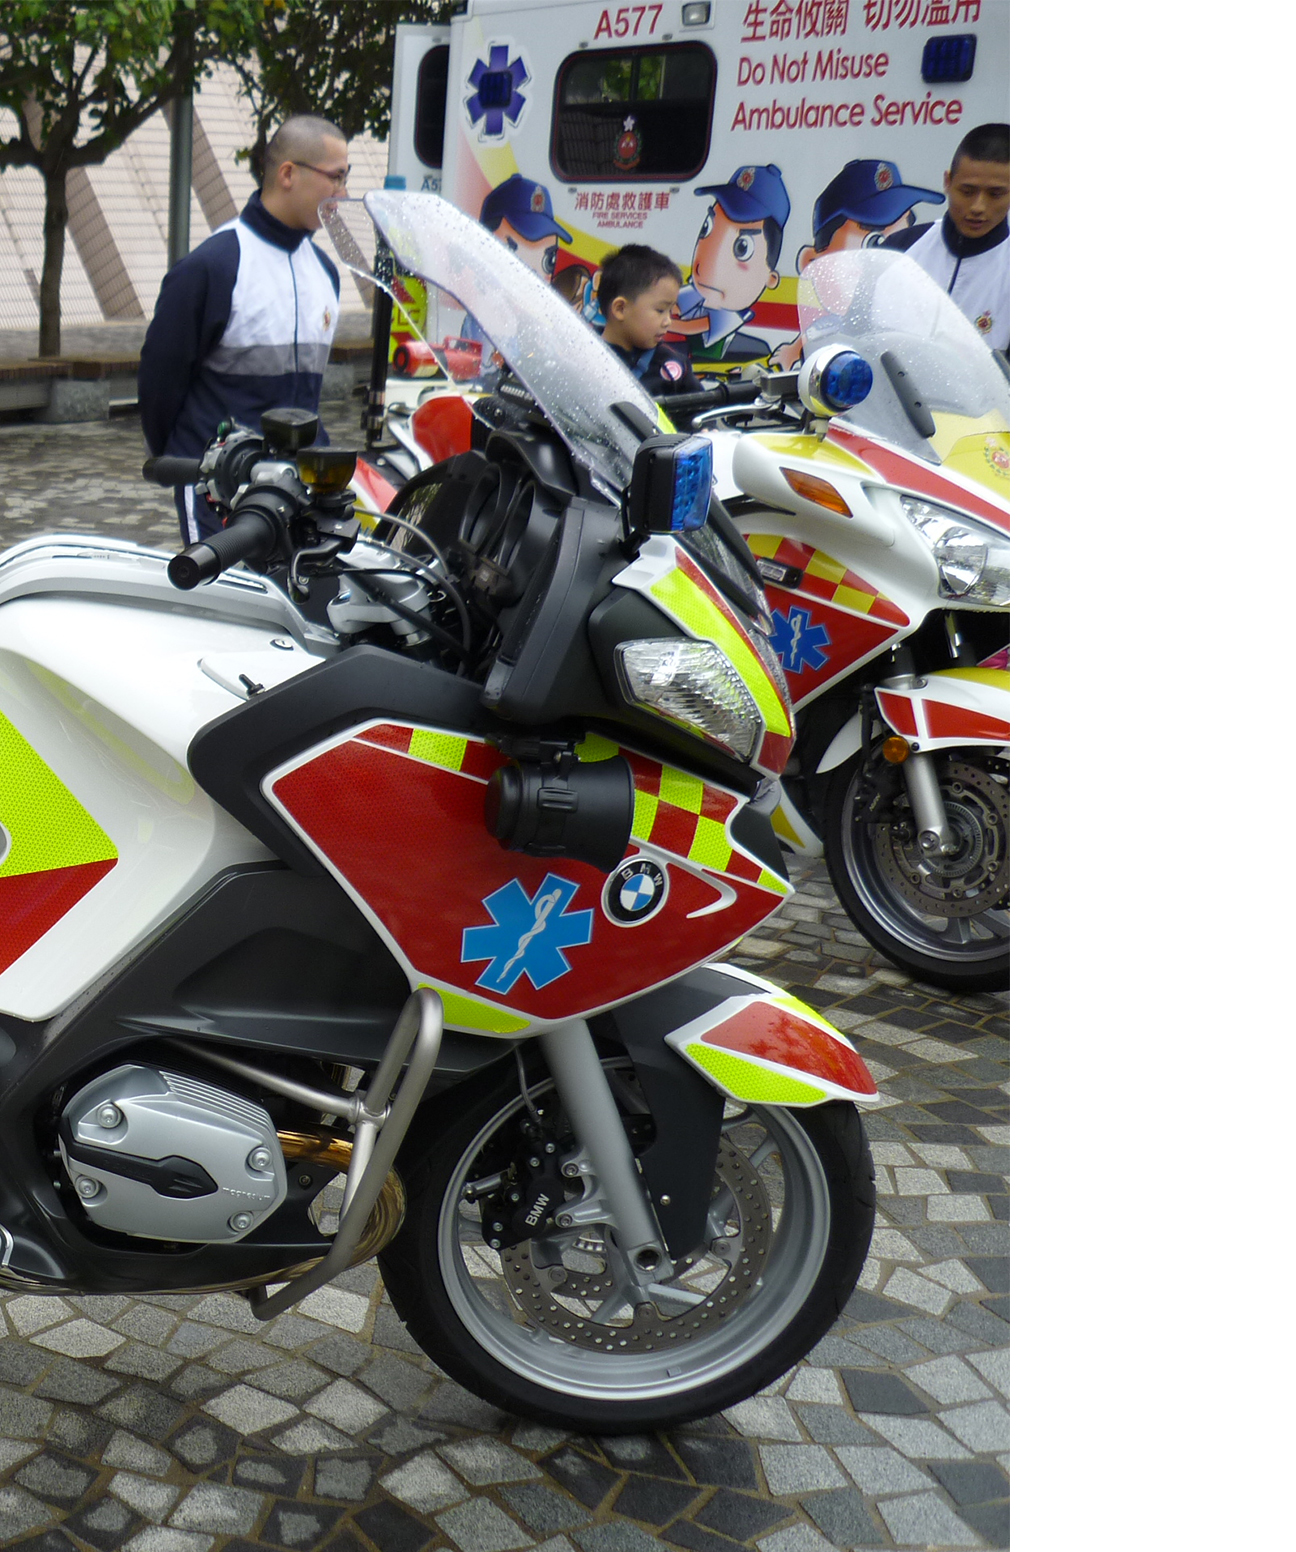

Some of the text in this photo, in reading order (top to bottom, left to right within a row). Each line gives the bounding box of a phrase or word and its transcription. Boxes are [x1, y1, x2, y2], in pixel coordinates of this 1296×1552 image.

[593, 3, 664, 40] A577
[741, 0, 851, 43] 生命攸關
[737, 47, 889, 87] Do Not Misuse
[730, 91, 963, 132] Ambulance Service
[574, 191, 671, 212] 消防處救護車
[592, 211, 648, 220] FIRE SERVICES
[597, 220, 644, 229] AMBULANCE
[621, 862, 664, 887] BMW
[525, 1193, 550, 1227] BMW
